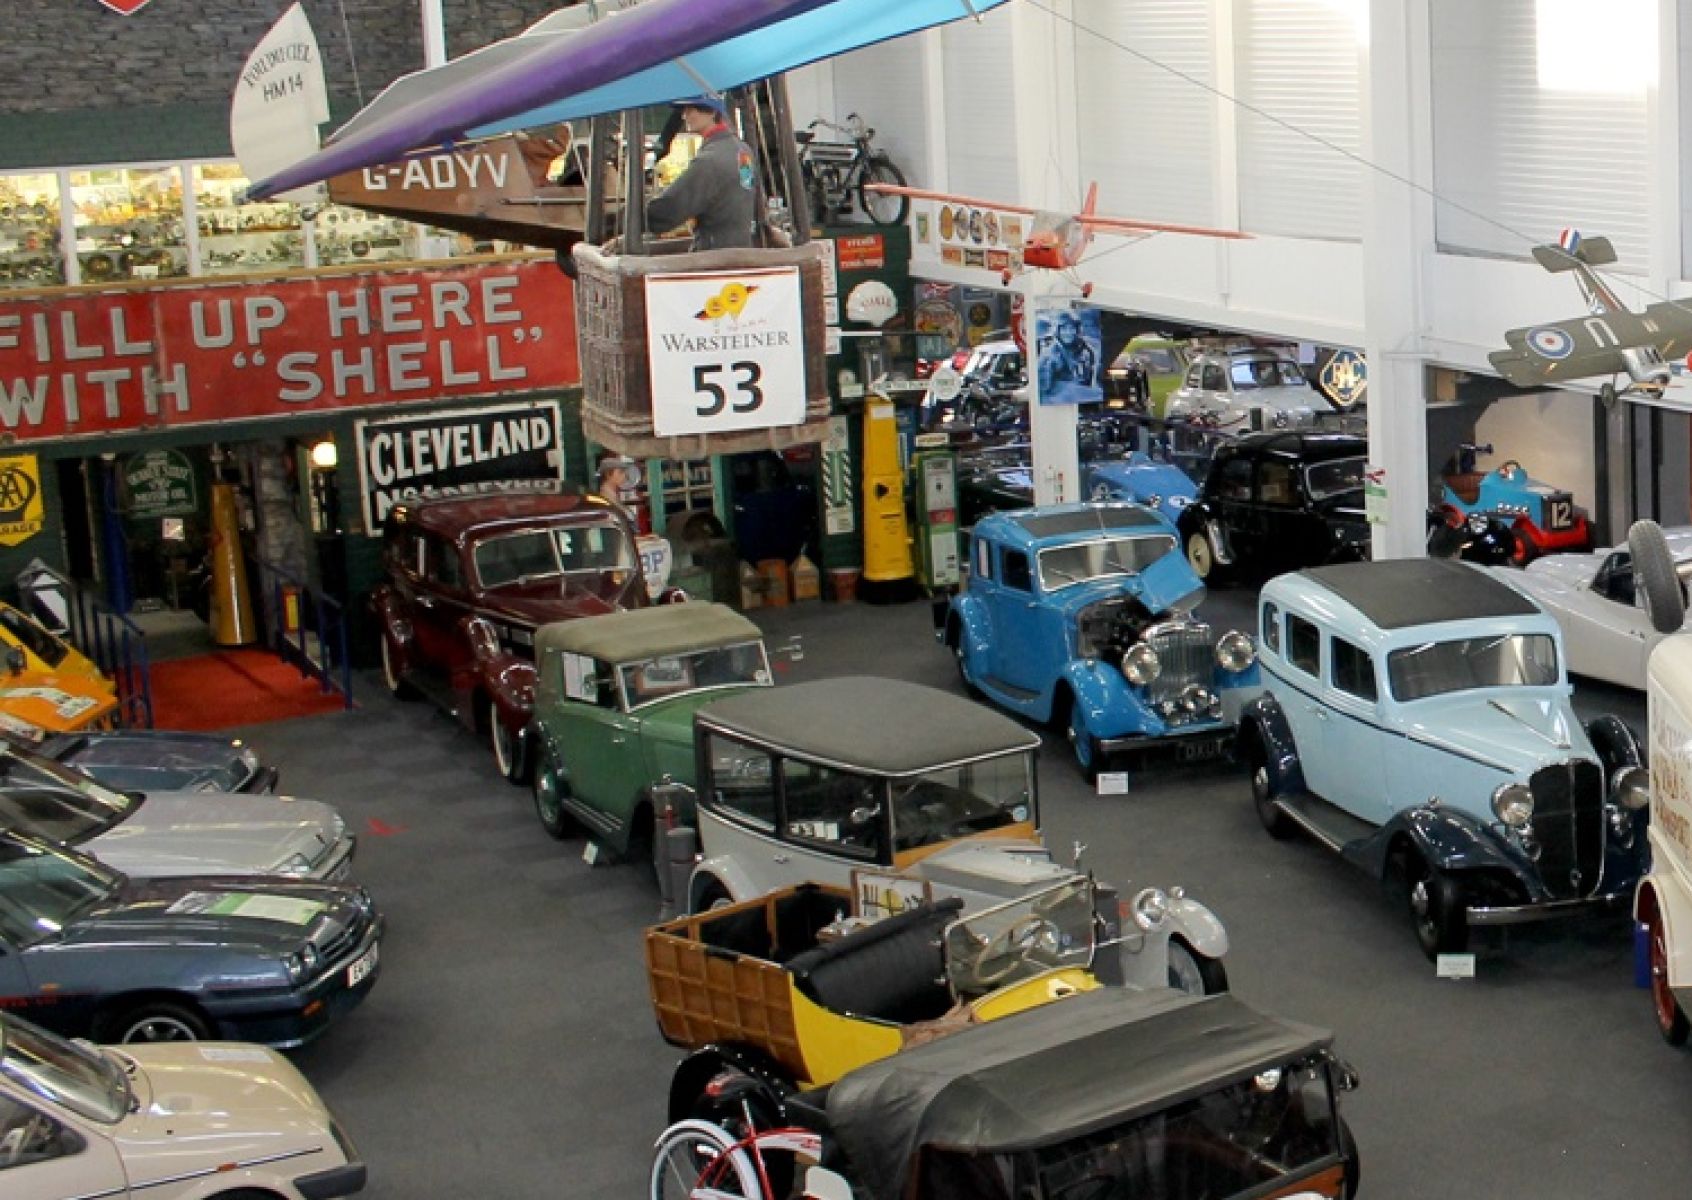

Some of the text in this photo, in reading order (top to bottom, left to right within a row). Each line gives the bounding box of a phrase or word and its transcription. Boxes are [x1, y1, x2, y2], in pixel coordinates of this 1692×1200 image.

[288, 72, 303, 93] 14
[362, 152, 508, 190] G-ADYV
[190, 296, 287, 349] UP
[326, 276, 521, 338] HERE
[661, 331, 790, 353] WARSTEINER
[0, 362, 190, 427] WITH
[693, 360, 763, 417] 53
[369, 416, 551, 486] CLEVELAND
[1551, 502, 1571, 528] 12
